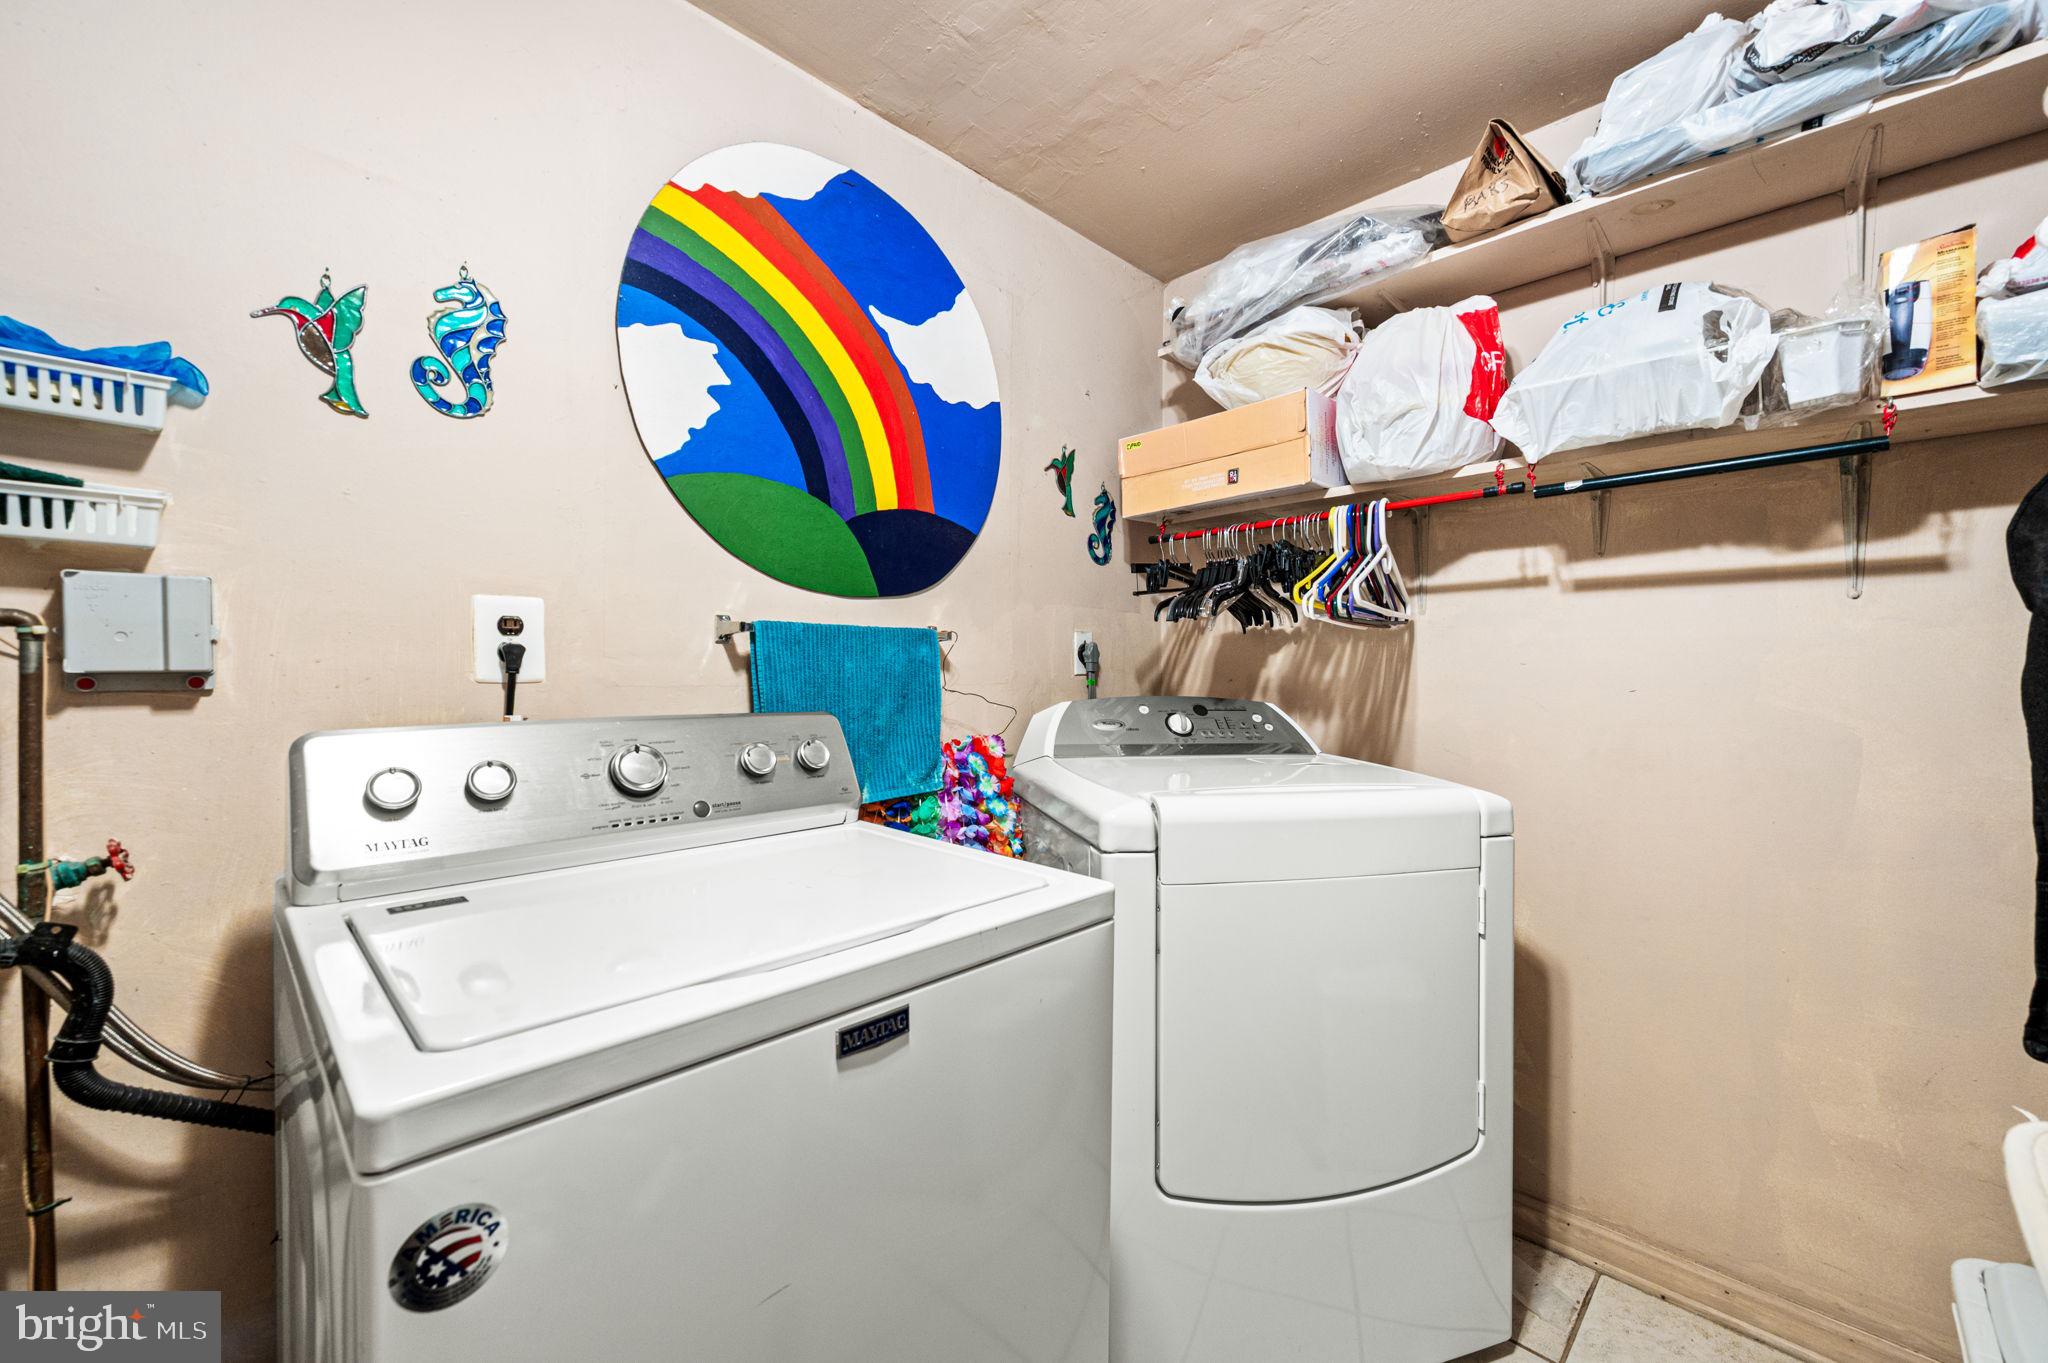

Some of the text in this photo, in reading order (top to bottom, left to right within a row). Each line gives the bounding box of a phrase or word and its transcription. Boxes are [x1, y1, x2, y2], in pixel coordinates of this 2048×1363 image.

[365, 836, 429, 852] MAYTAG
[842, 1013, 907, 1051] MAYTAG
[401, 1207, 501, 1262] AMERICA
